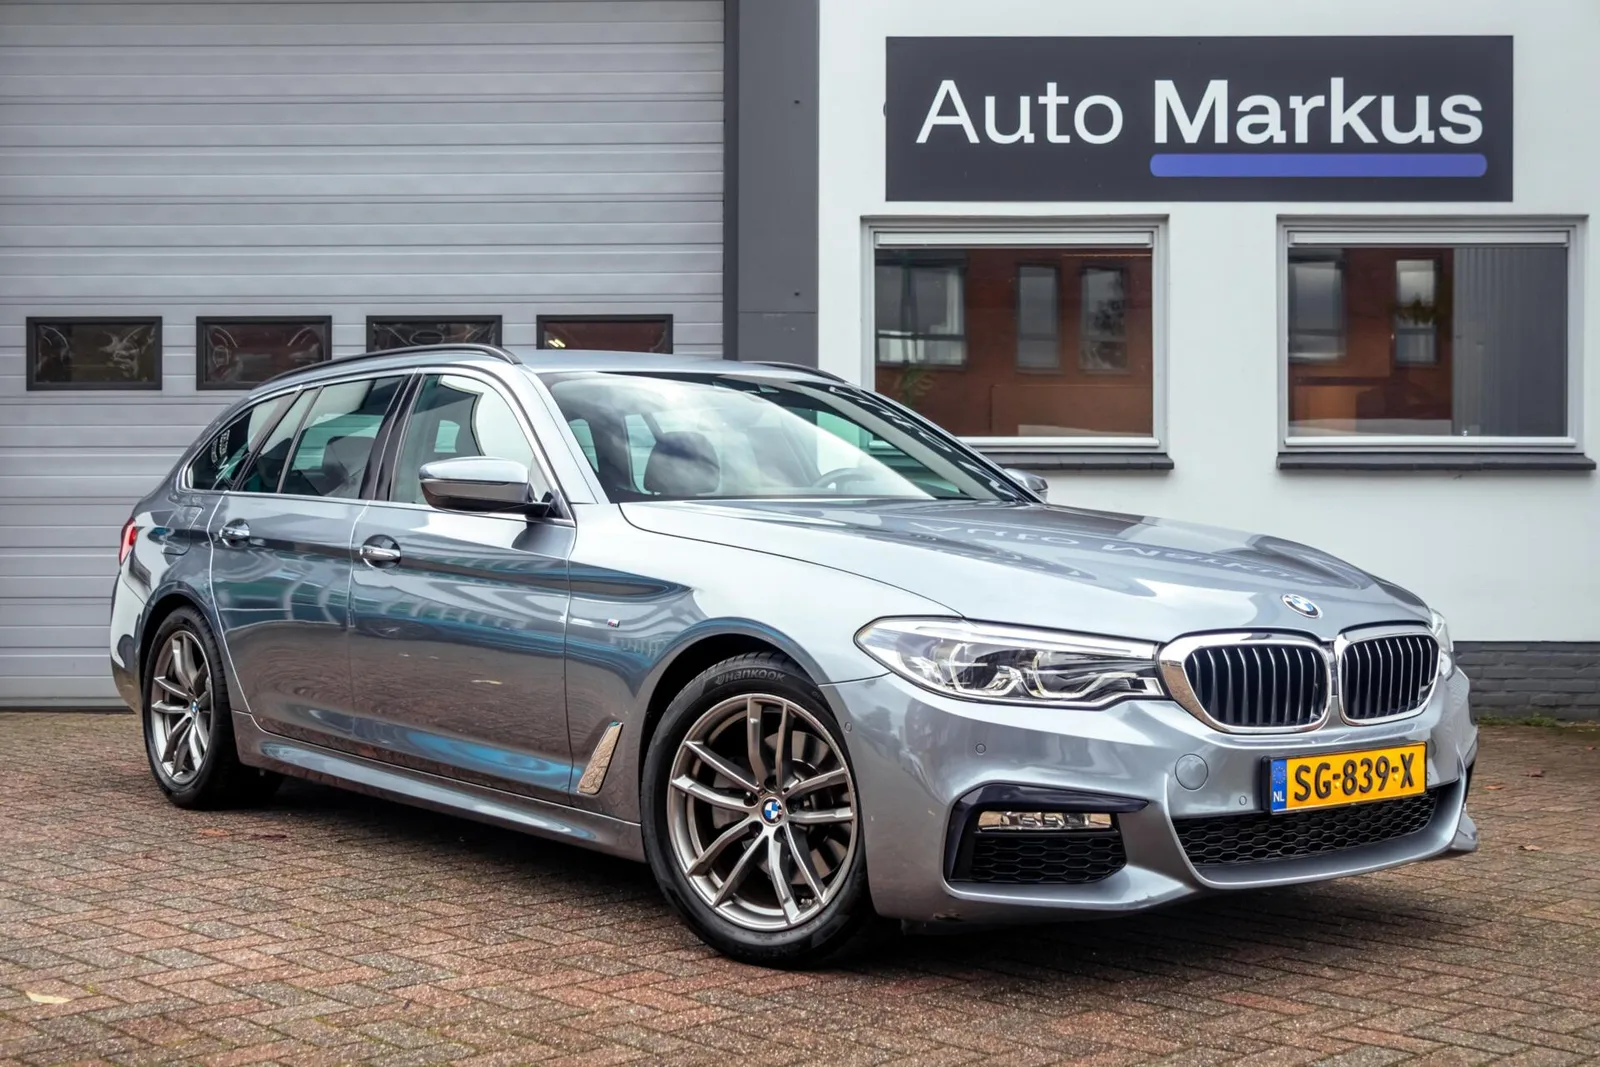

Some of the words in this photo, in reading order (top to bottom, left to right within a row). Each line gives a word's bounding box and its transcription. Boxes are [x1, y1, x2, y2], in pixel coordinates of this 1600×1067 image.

[915, 80, 1124, 145] Auto
[1155, 77, 1483, 145] Markus
[1273, 791, 1286, 803] NL
[1294, 752, 1415, 802] SG-839-X
